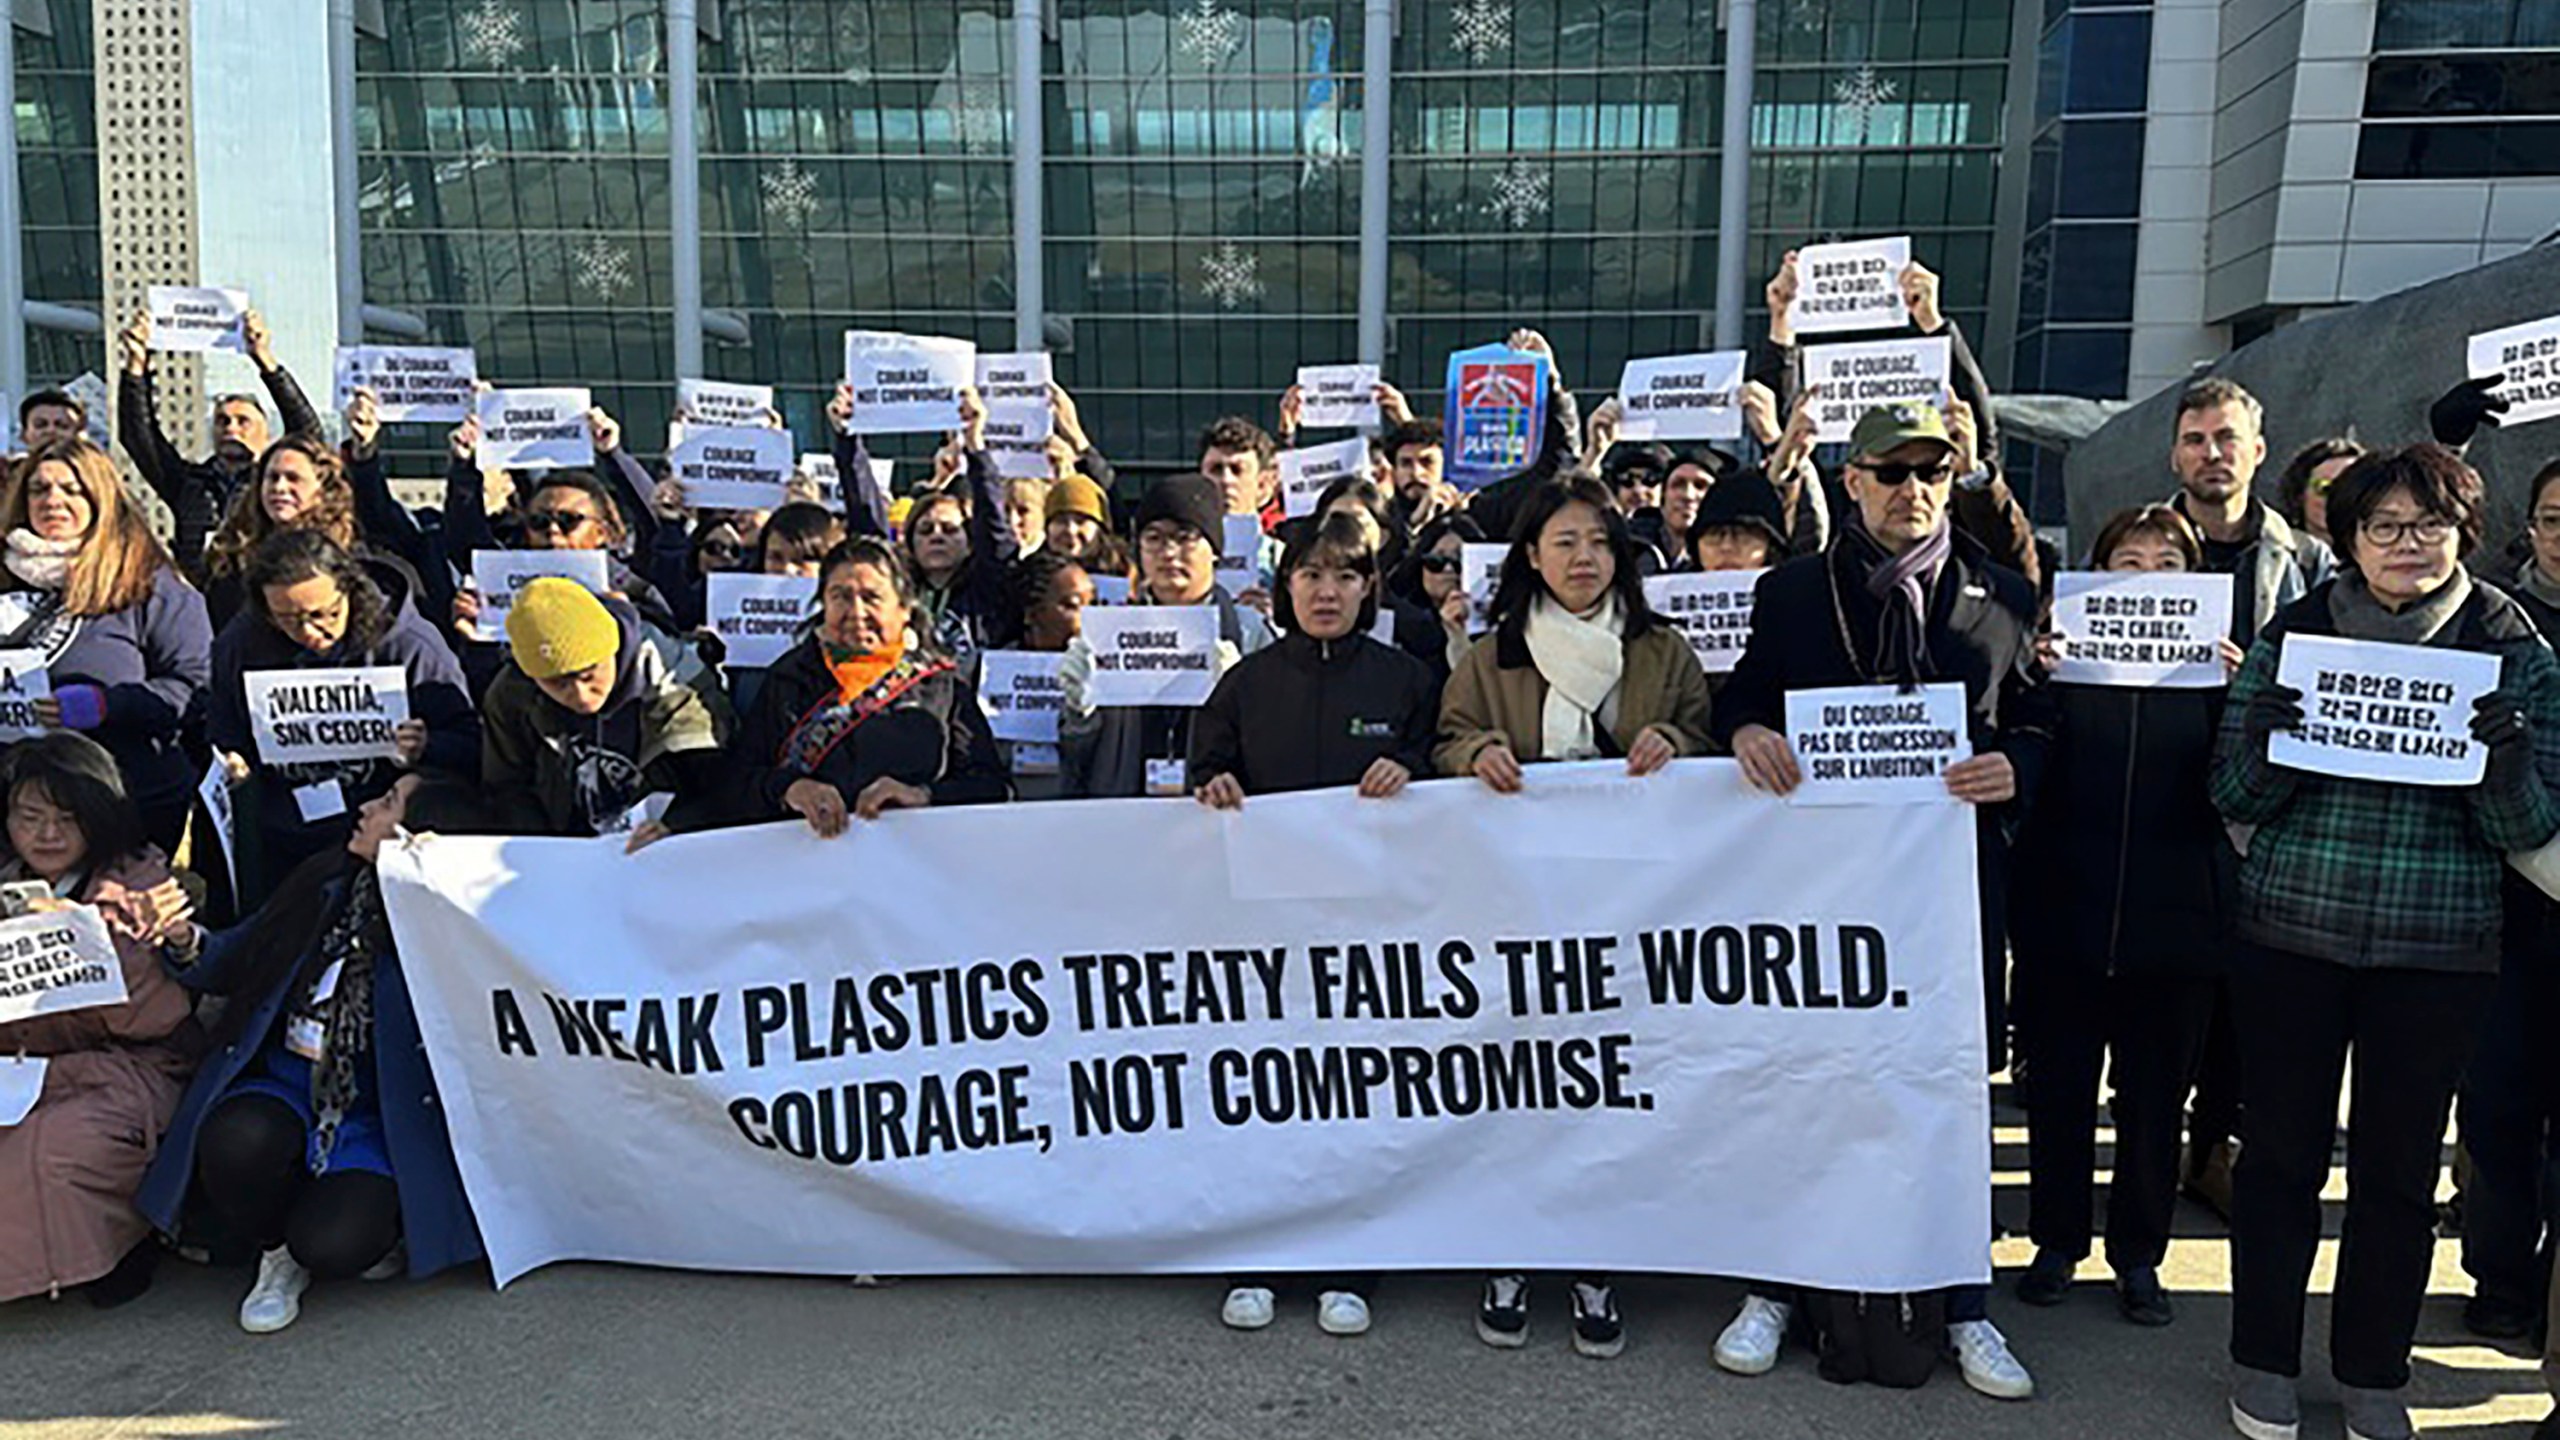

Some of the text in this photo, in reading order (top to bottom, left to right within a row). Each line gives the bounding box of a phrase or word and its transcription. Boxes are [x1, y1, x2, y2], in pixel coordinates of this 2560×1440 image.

[2502, 337, 2560, 363] 절충안
[876, 369, 930, 384] COURAGE
[1831, 359, 1850, 378] DU
[1652, 374, 1706, 391] COURAGE
[1839, 381, 1856, 399] DE
[857, 387, 954, 403] NOT COMPROMISE
[1628, 392, 1729, 410] NOT COMPROMISE
[504, 406, 556, 424] COURAGE
[484, 424, 581, 443] NOT COMPROMISE
[703, 446, 756, 463] COURAGE
[682, 464, 781, 483] NOT COMPROMISE
[742, 598, 799, 615] COURAGE
[718, 617, 801, 635] NOT COMPRO
[1117, 631, 1179, 649] COURAGE
[1095, 652, 1209, 670] NOT COMPROMISE
[2157, 644, 2213, 663] 나서라
[2317, 670, 2454, 705] 절충안은 없다
[989, 694, 1013, 710] NOT
[2319, 697, 2362, 723] 각국
[1823, 702, 1931, 727] DU COURAGE,
[273, 721, 312, 746] SIN
[1799, 729, 1956, 753] PAS DE CONCESSION
[2400, 733, 2468, 760] 나서라
[1813, 758, 1846, 779] SUR
[37, 928, 76, 949] 없다
[51, 964, 108, 988] 나서라
[493, 923, 1909, 1075] A WEAK PLASTICS TREATY FAILS THE WORLD.
[727, 1033, 1655, 1167] COURAGE, NOT COMPROMISE.
